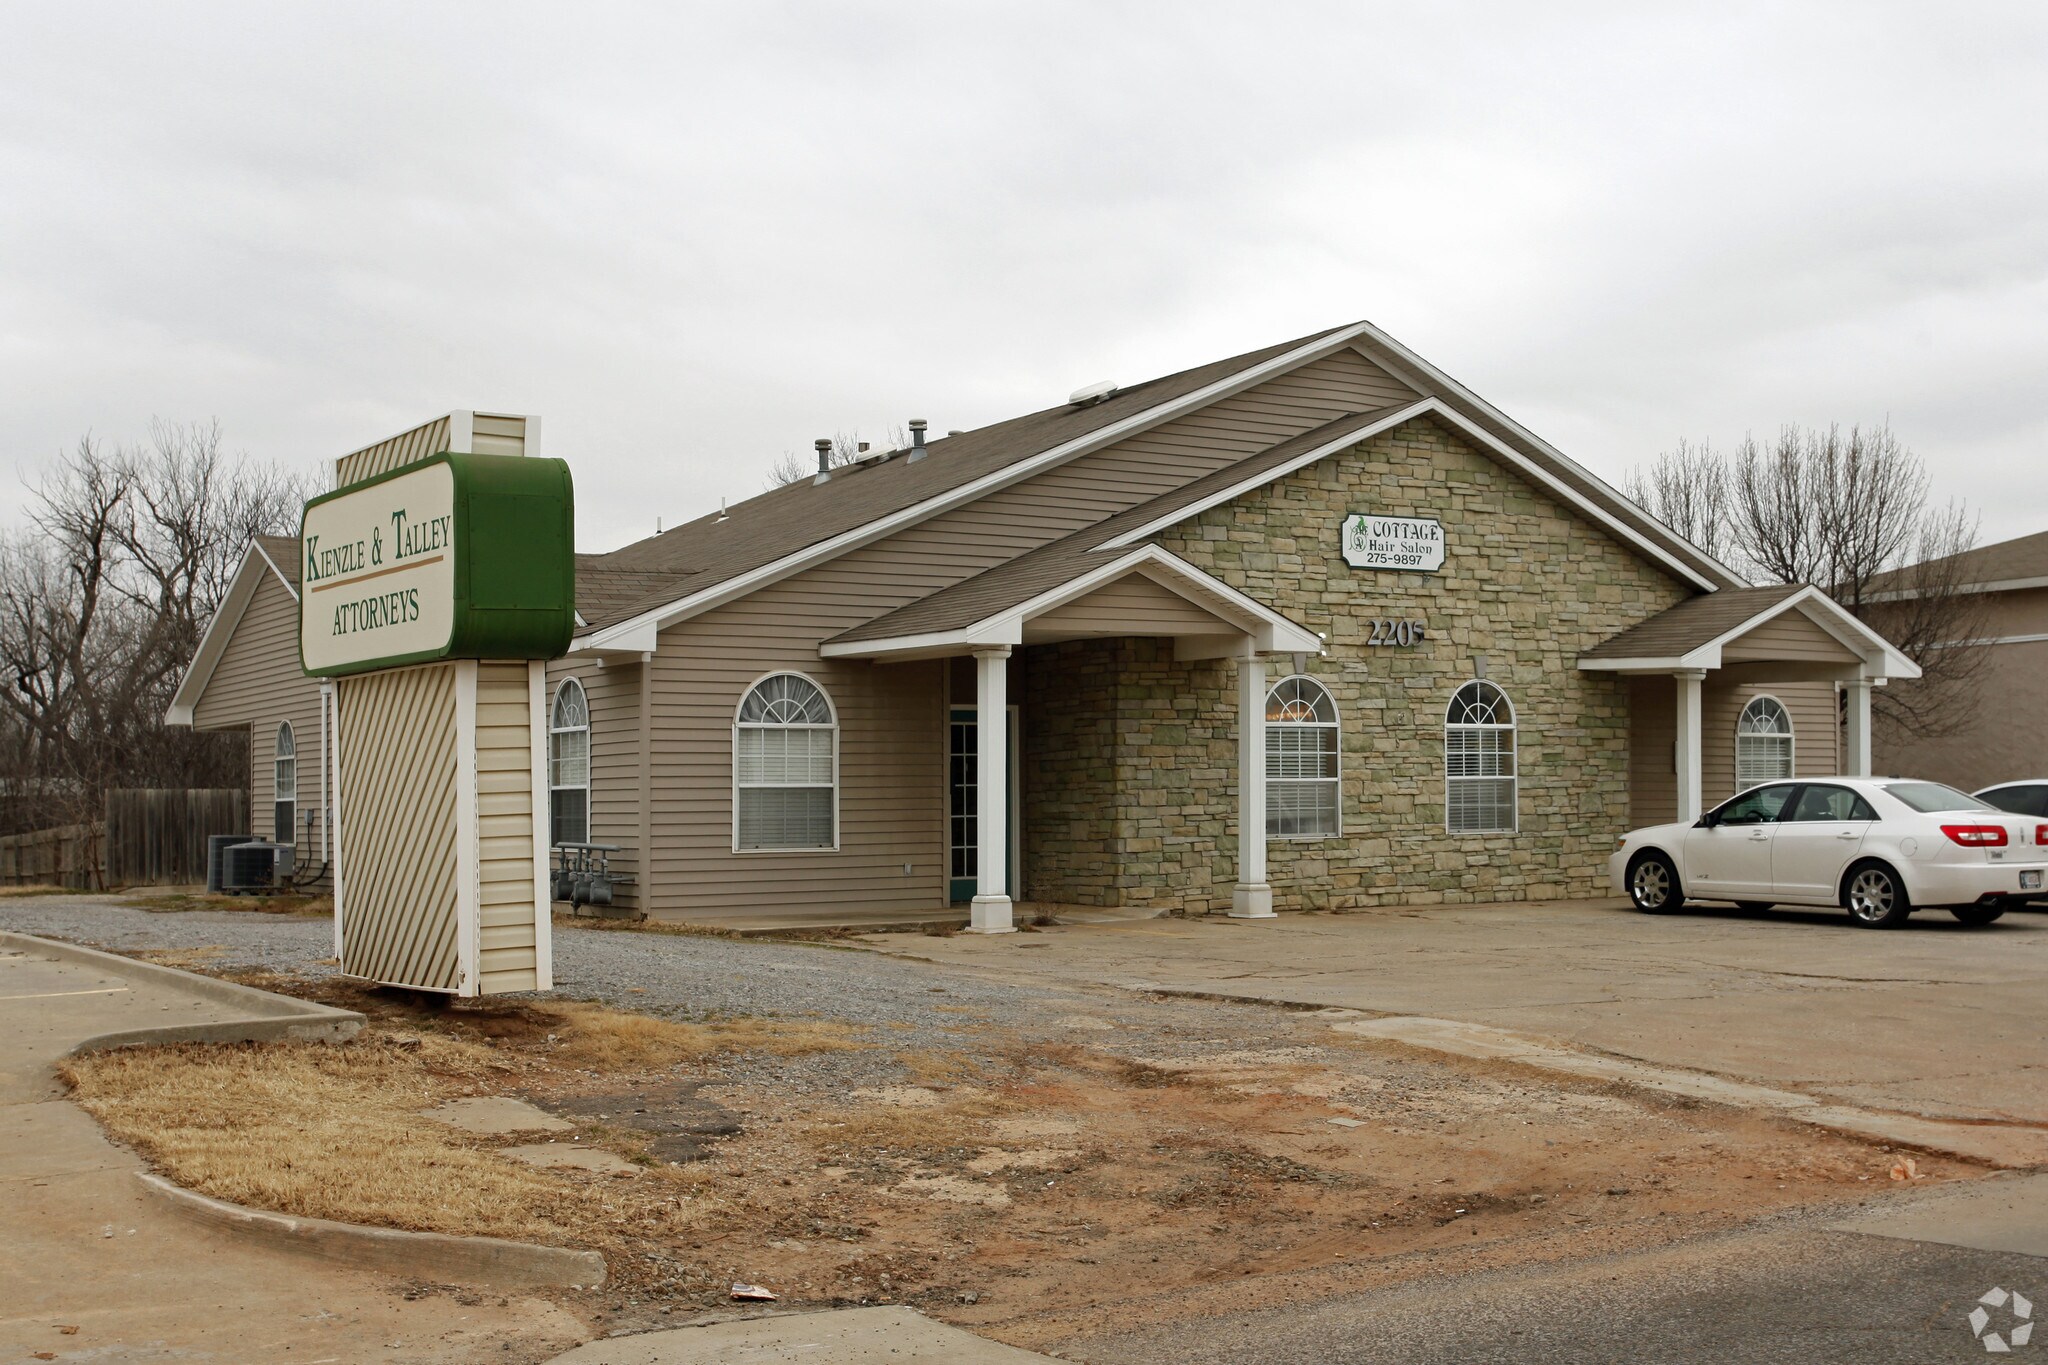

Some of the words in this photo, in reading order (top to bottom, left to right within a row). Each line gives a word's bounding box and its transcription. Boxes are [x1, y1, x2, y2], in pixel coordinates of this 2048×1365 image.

[1373, 521, 1439, 541] COTTAGE
[306, 534, 365, 582] KIENZLE
[371, 526, 383, 566] &
[391, 508, 451, 560] TALLEY
[1369, 540, 1396, 552] Hair
[1400, 541, 1433, 555] Salon
[1367, 552, 1423, 565] 275-9897
[332, 588, 419, 636] ATTORNEYS
[1366, 619, 1425, 647] 2205
